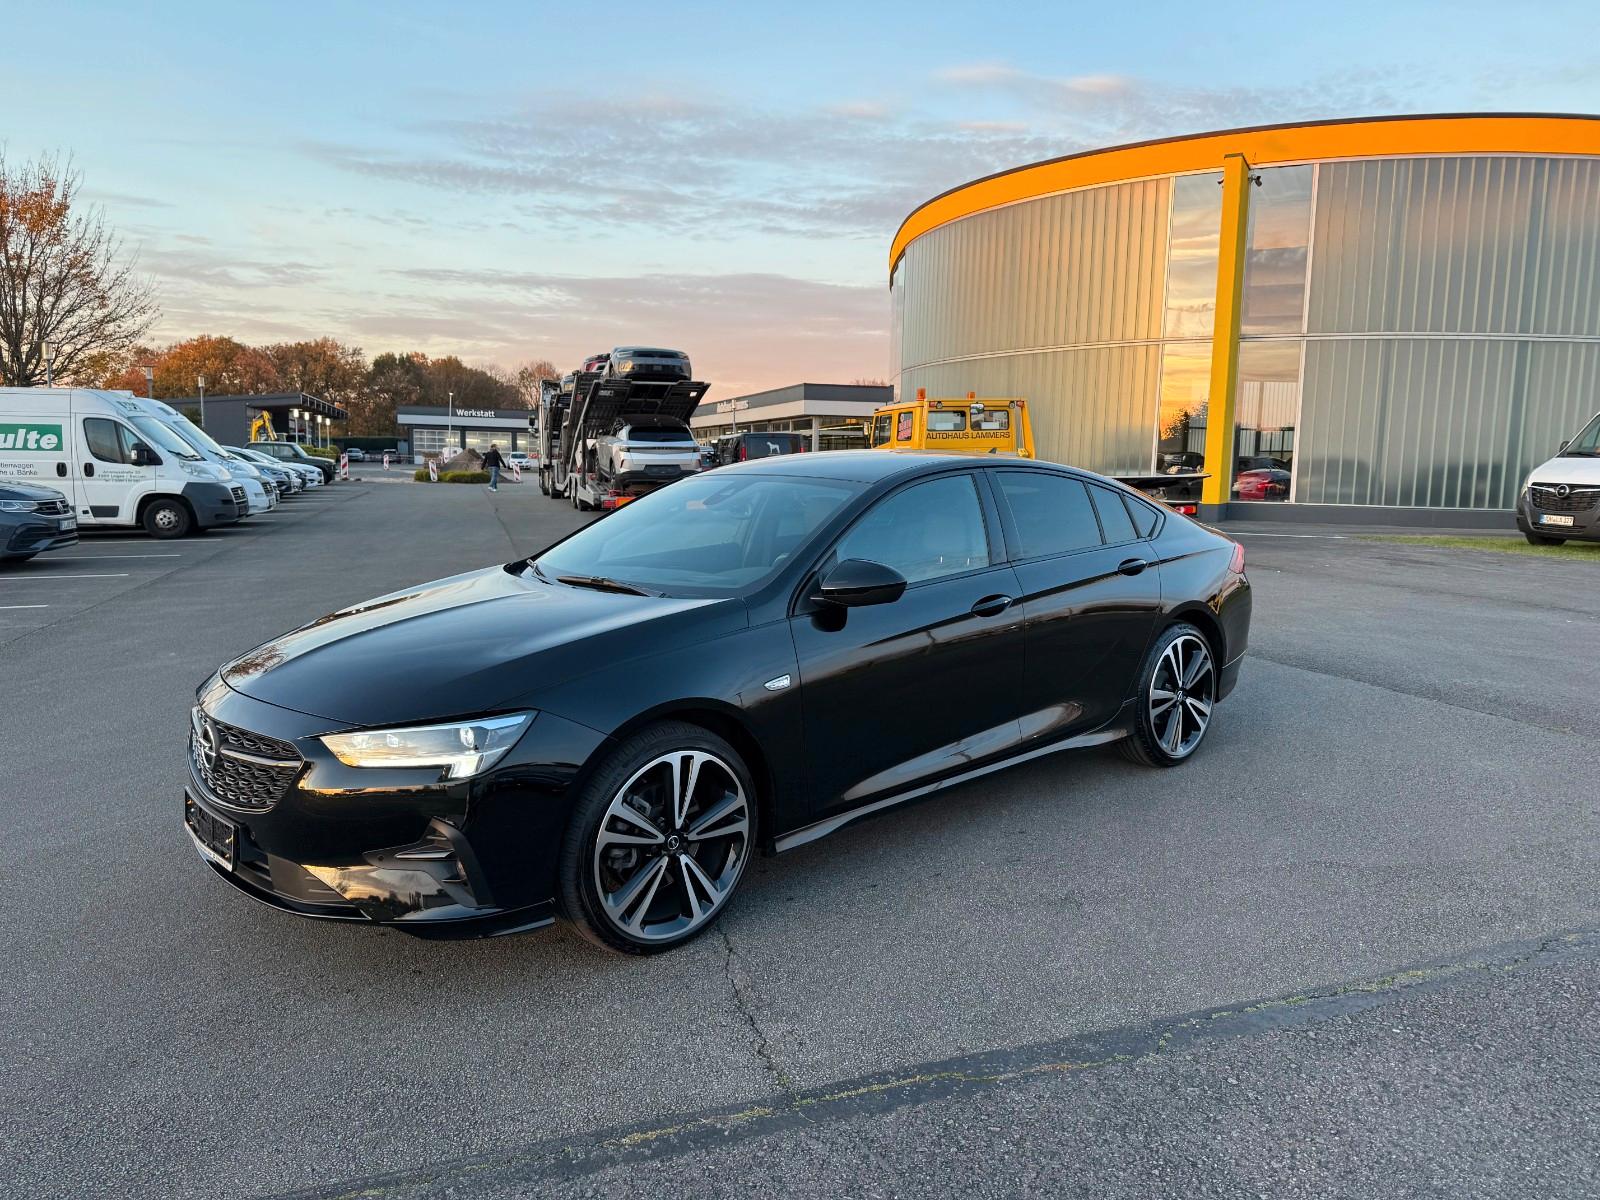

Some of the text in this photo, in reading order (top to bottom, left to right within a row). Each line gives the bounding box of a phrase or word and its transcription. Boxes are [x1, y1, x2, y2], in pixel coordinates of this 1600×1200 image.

[456, 409, 495, 418] Werkstatt
[0, 428, 58, 449] ulte
[926, 431, 1010, 440] AUTOHAUS LAMMERS
